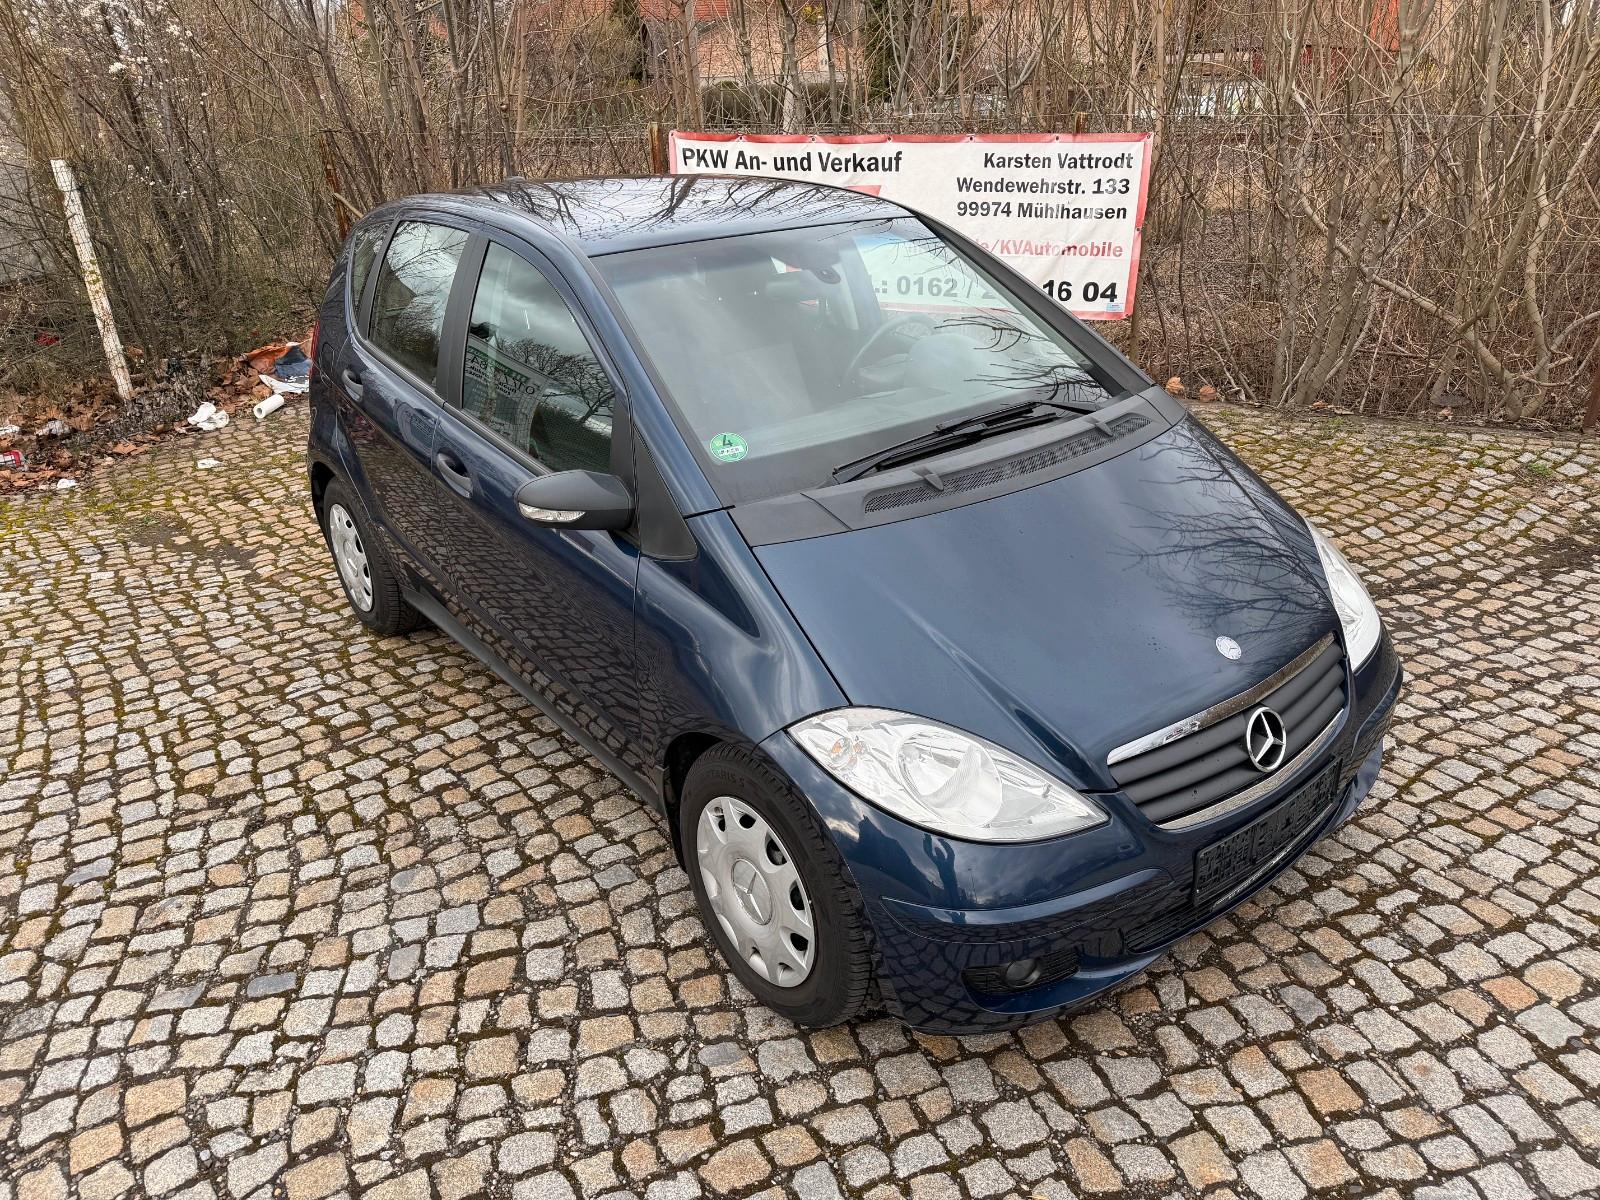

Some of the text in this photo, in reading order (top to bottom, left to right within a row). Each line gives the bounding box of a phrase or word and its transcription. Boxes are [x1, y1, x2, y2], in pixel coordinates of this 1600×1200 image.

[682, 148, 903, 173] PKW An- und Verkauf
[983, 152, 1134, 170] Karsten Vattrodt
[956, 176, 1130, 195] Wendewehrstr. 133
[957, 201, 1127, 220] 99974 Mühlhausen
[896, 275, 958, 298] 0162
[1042, 279, 1072, 302] 16
[1082, 281, 1118, 303] 04
[722, 434, 733, 447] 4
